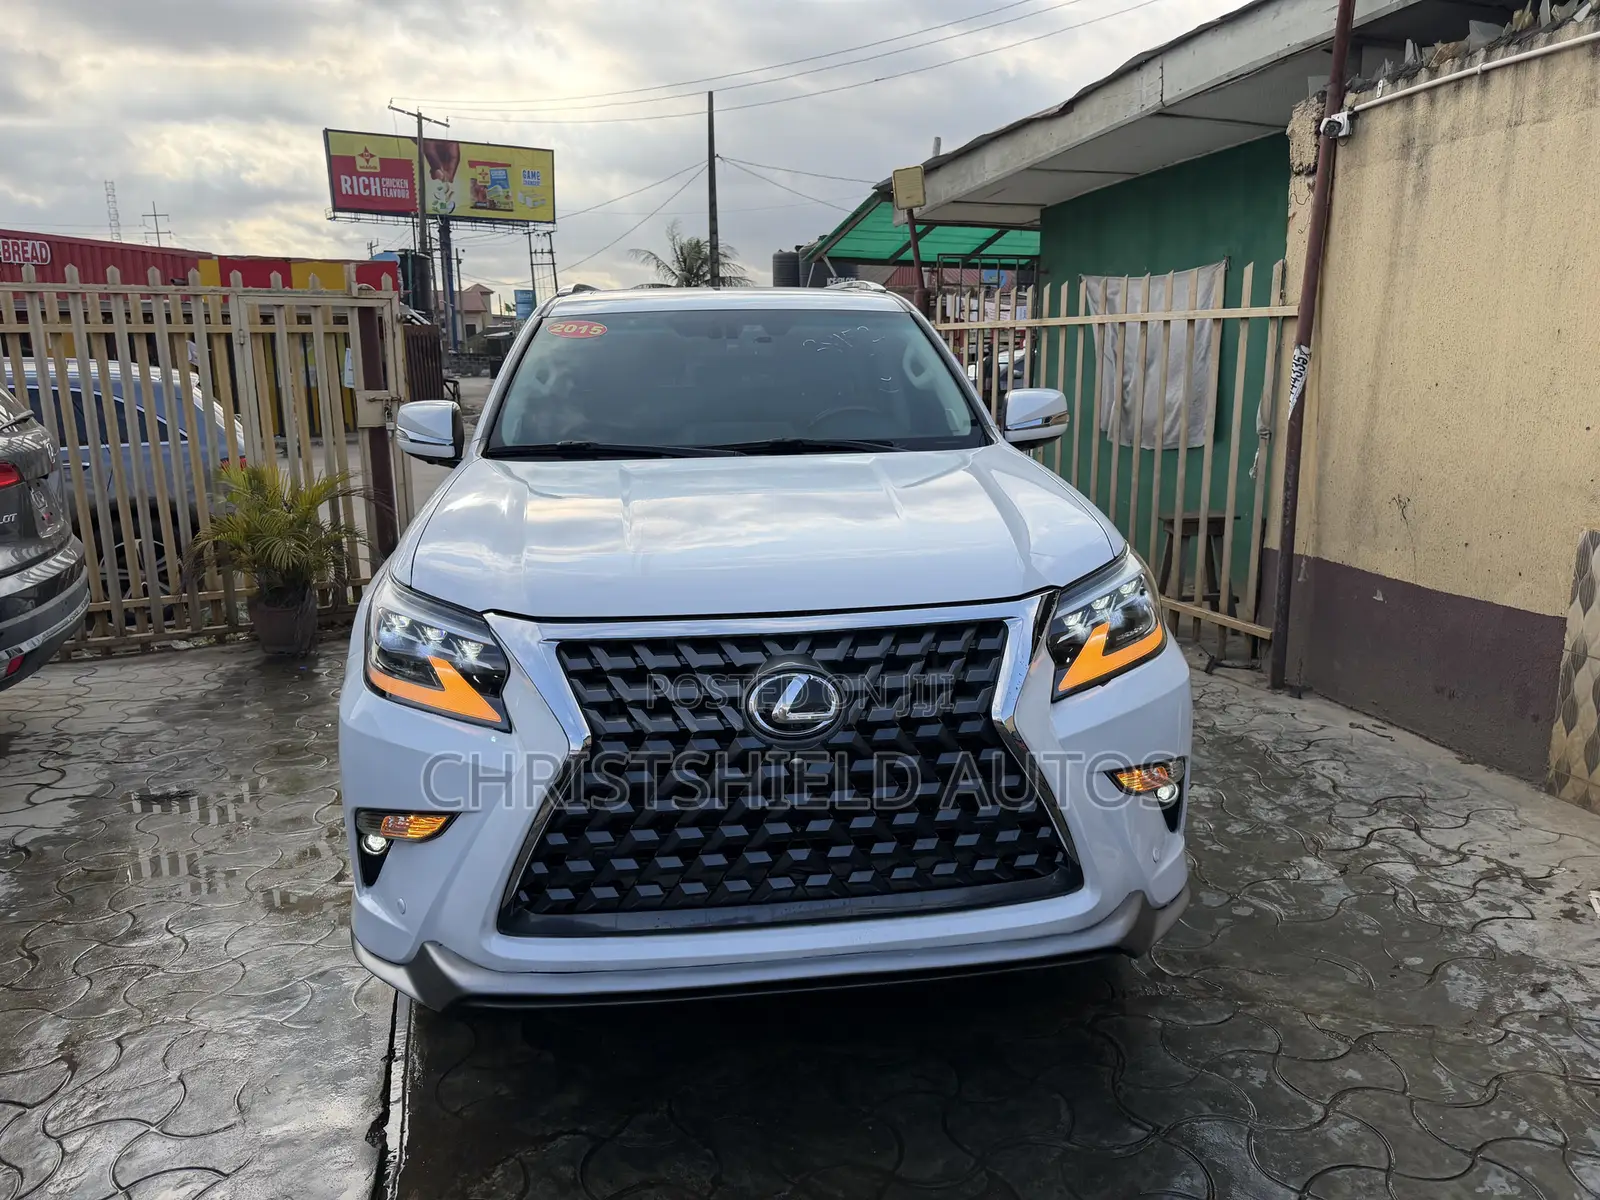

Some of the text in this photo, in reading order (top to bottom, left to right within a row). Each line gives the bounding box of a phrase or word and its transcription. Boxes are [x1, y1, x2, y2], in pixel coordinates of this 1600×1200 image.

[522, 169, 541, 181] GAME
[340, 174, 381, 197] RICH
[381, 177, 409, 189] CHICKEN
[382, 187, 410, 199] FLAVOUR
[1, 239, 51, 264] BREAD
[550, 323, 604, 335] 2015
